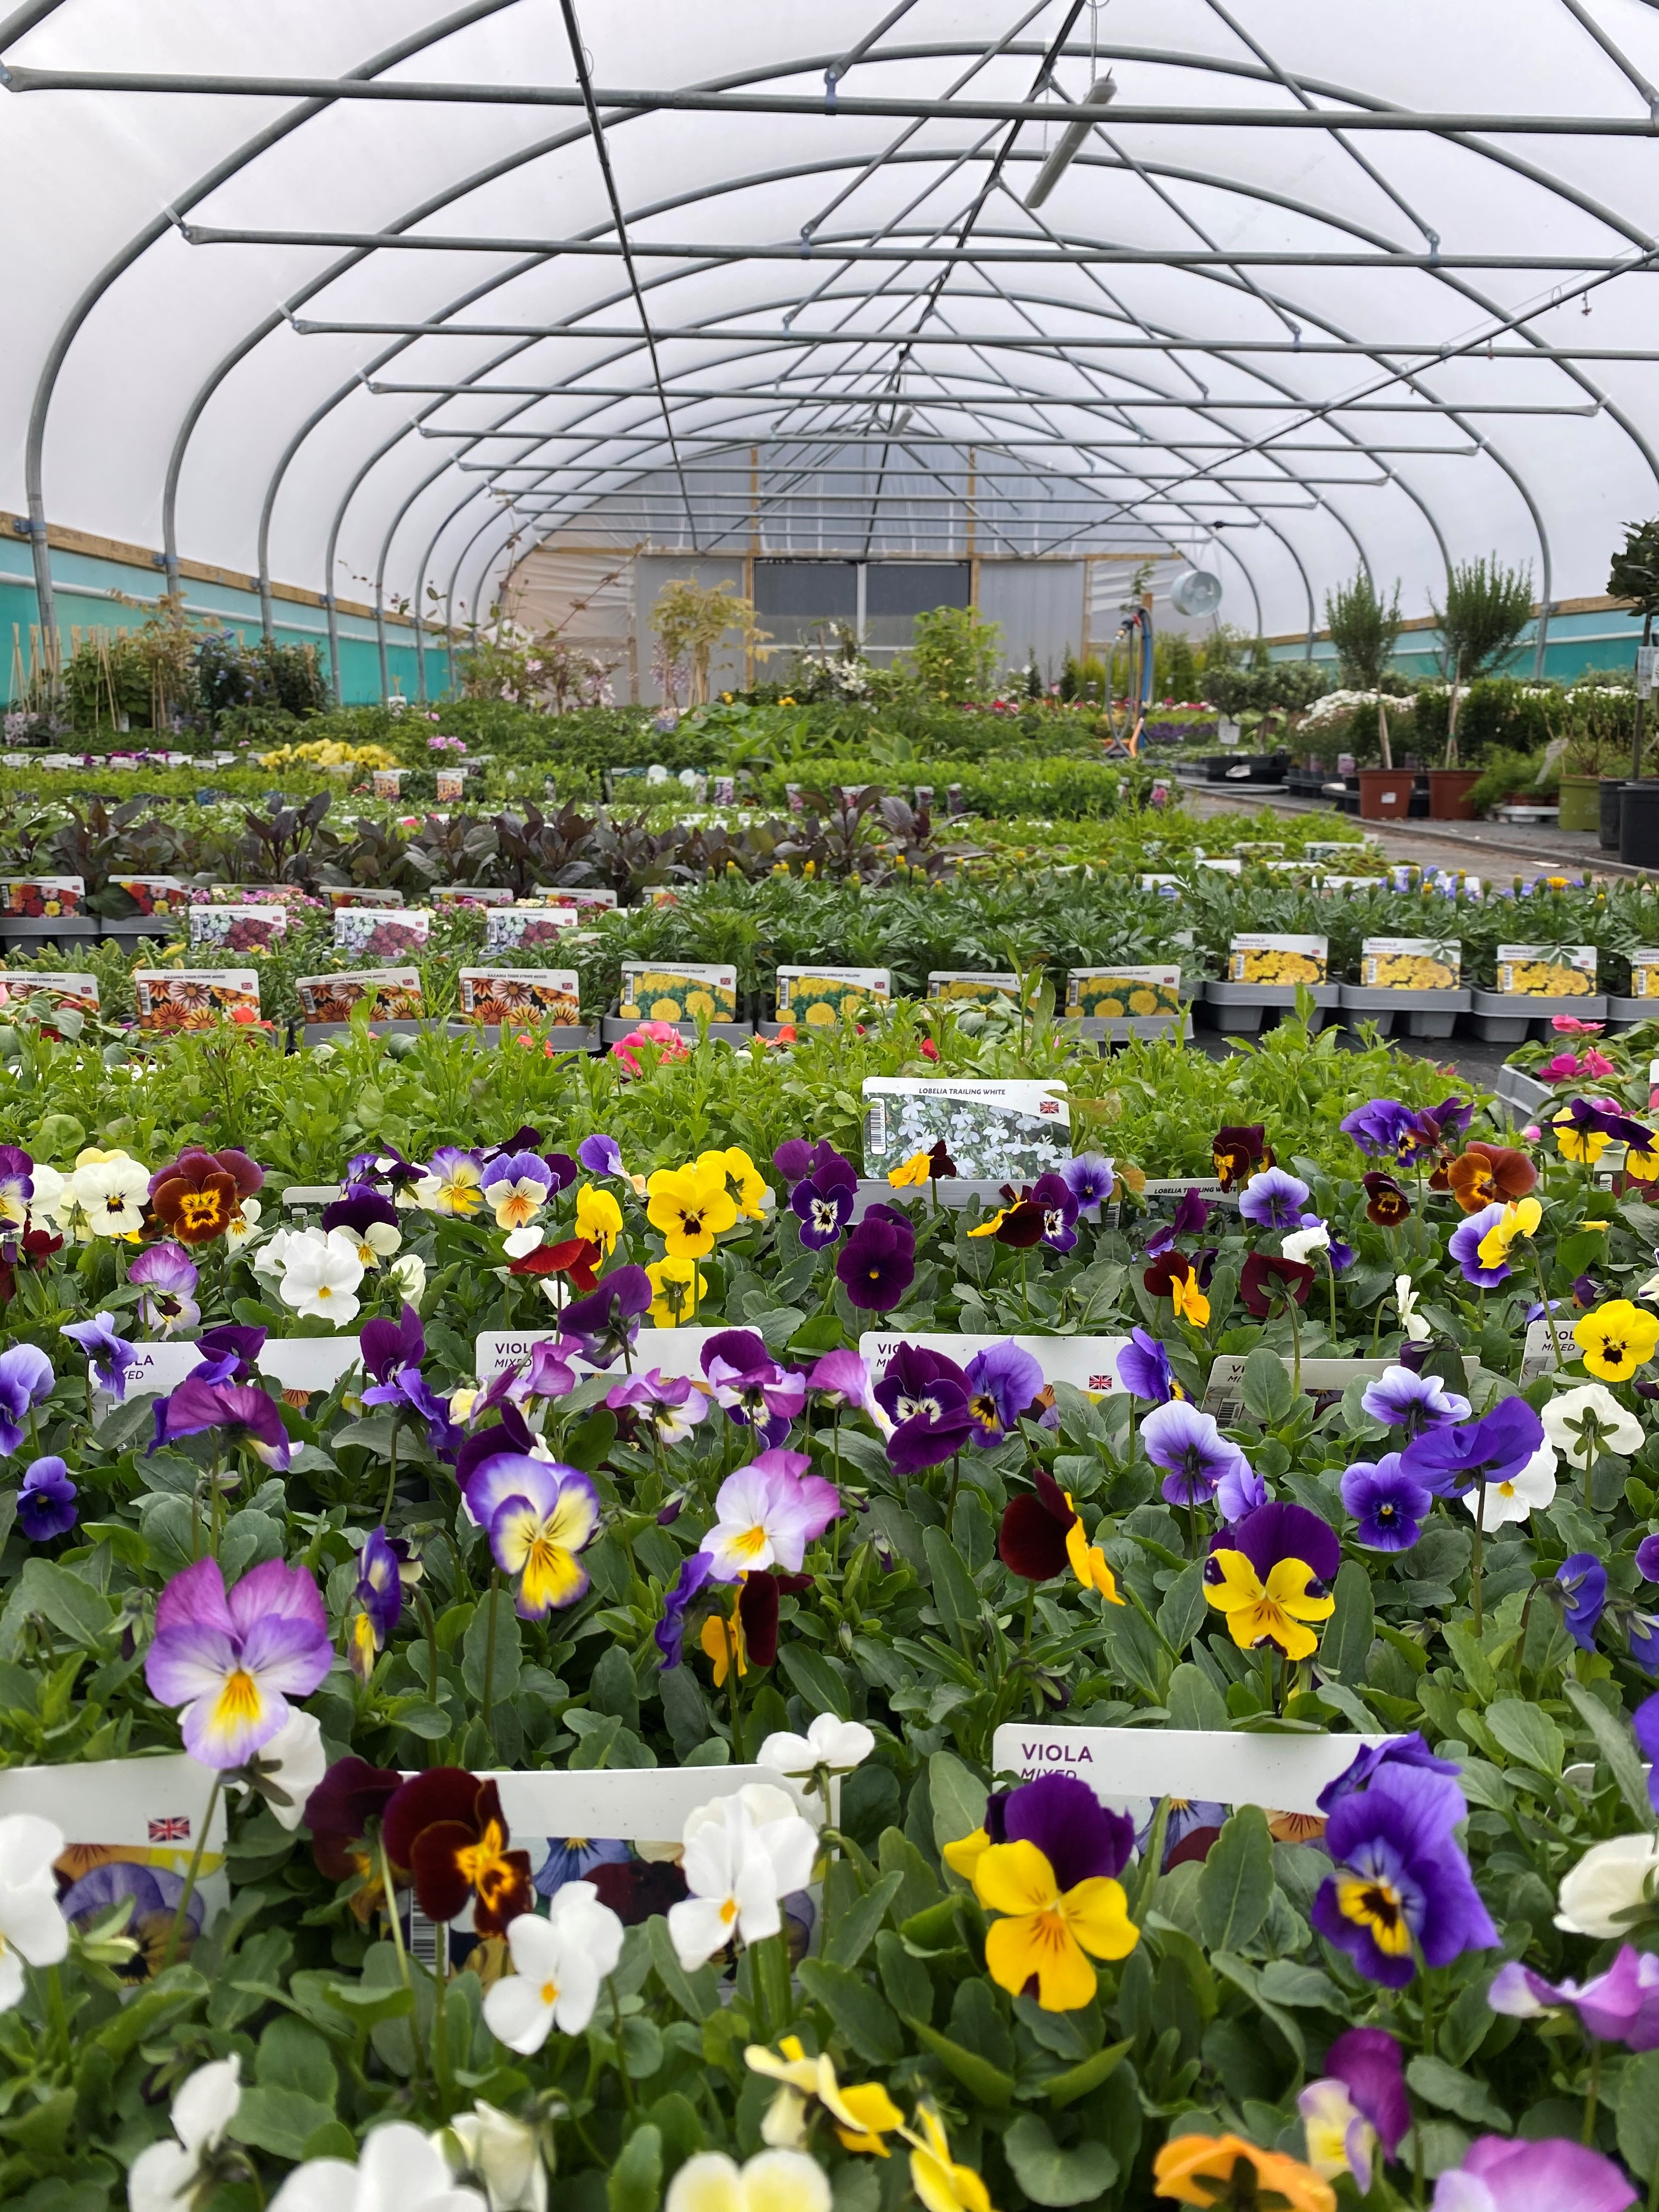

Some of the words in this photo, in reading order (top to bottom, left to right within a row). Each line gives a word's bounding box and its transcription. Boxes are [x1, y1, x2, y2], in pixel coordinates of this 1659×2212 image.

[1545, 1331, 1575, 1340] VOL
[495, 1343, 528, 1354] VIOL
[1021, 1743, 1093, 1763] VIOLA
